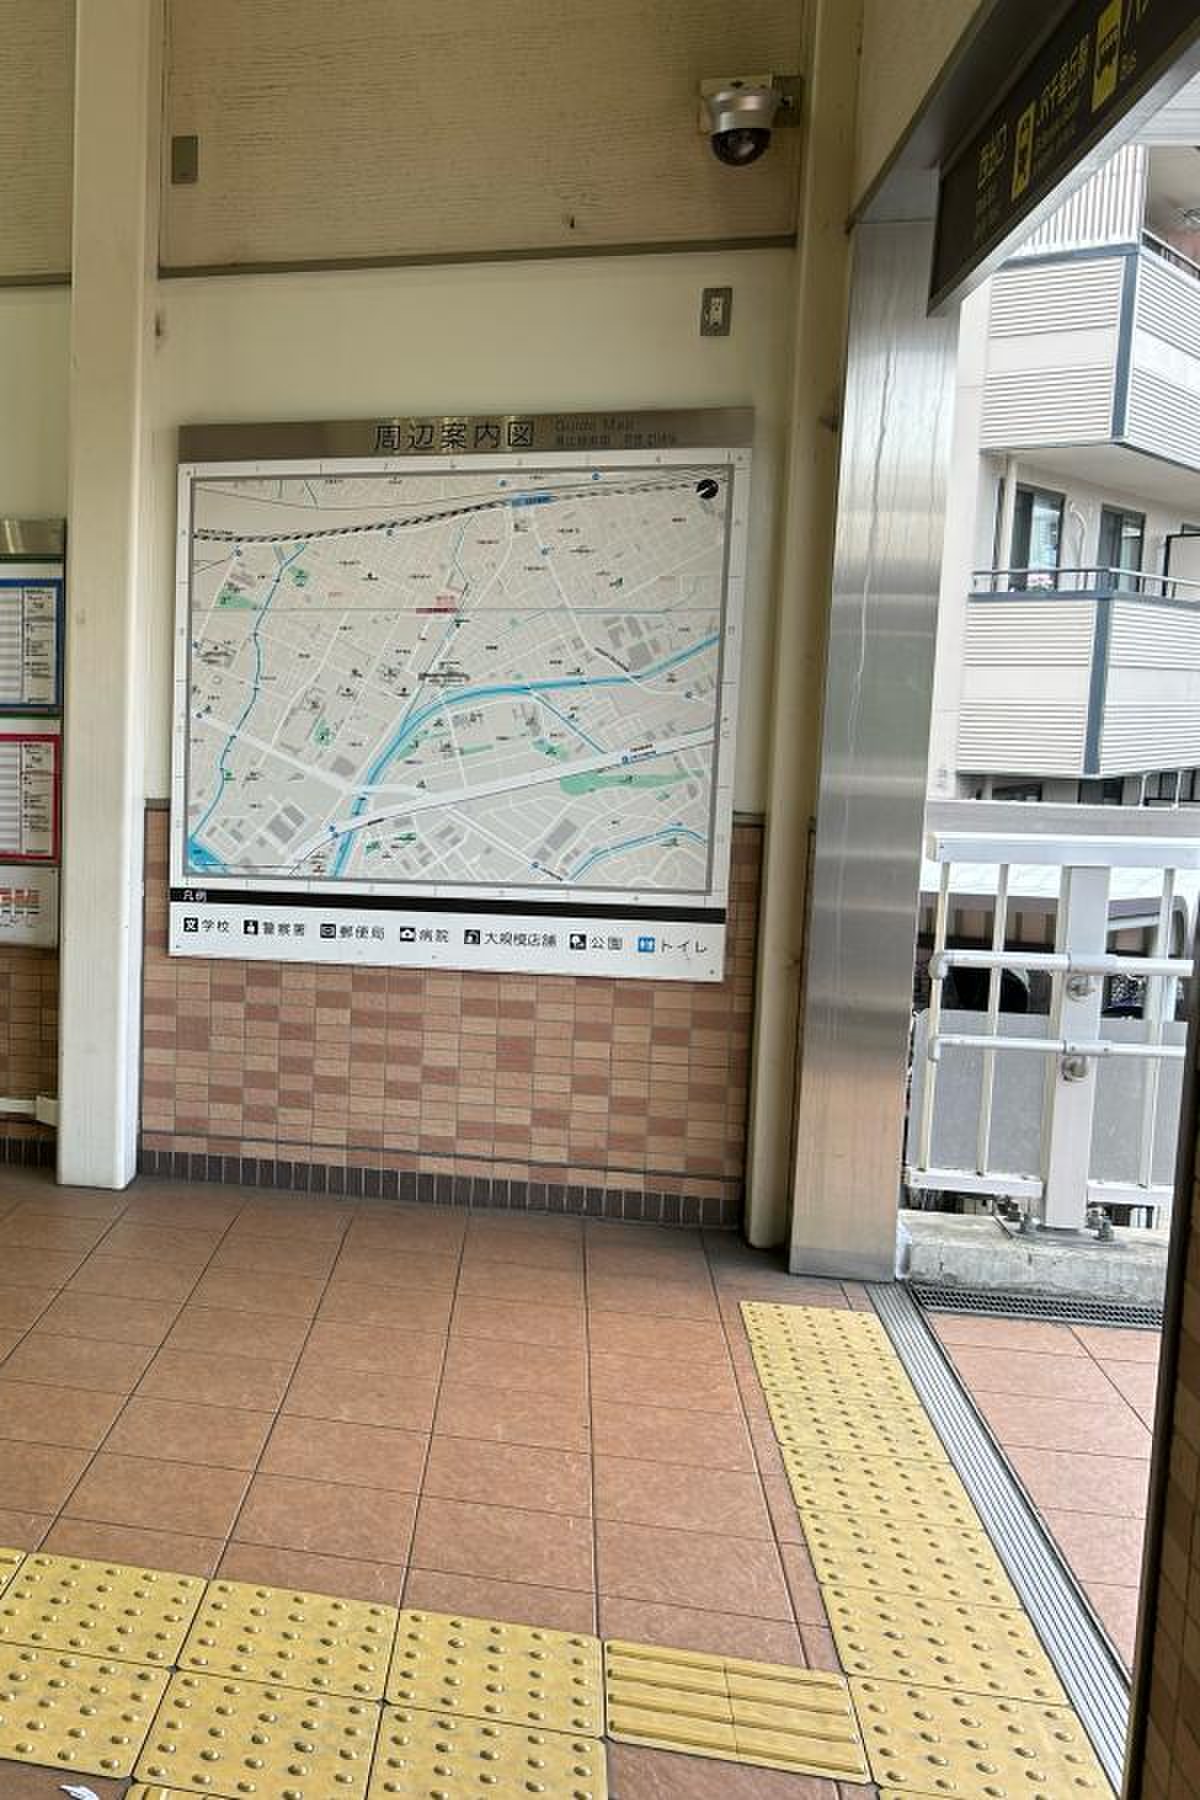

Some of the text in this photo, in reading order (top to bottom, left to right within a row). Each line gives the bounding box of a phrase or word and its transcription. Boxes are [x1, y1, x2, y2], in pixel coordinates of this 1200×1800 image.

[375, 420, 535, 450] 周辺案内図
[183, 889, 208, 902] 凡例
[201, 919, 230, 933] 学校
[262, 920, 305, 936] 警察署
[338, 923, 385, 941] 郵便局
[419, 928, 449, 943] 病院
[483, 931, 557, 947] 大規模店舗
[589, 936, 623, 950] 公園
[660, 940, 707, 957] トイレ
